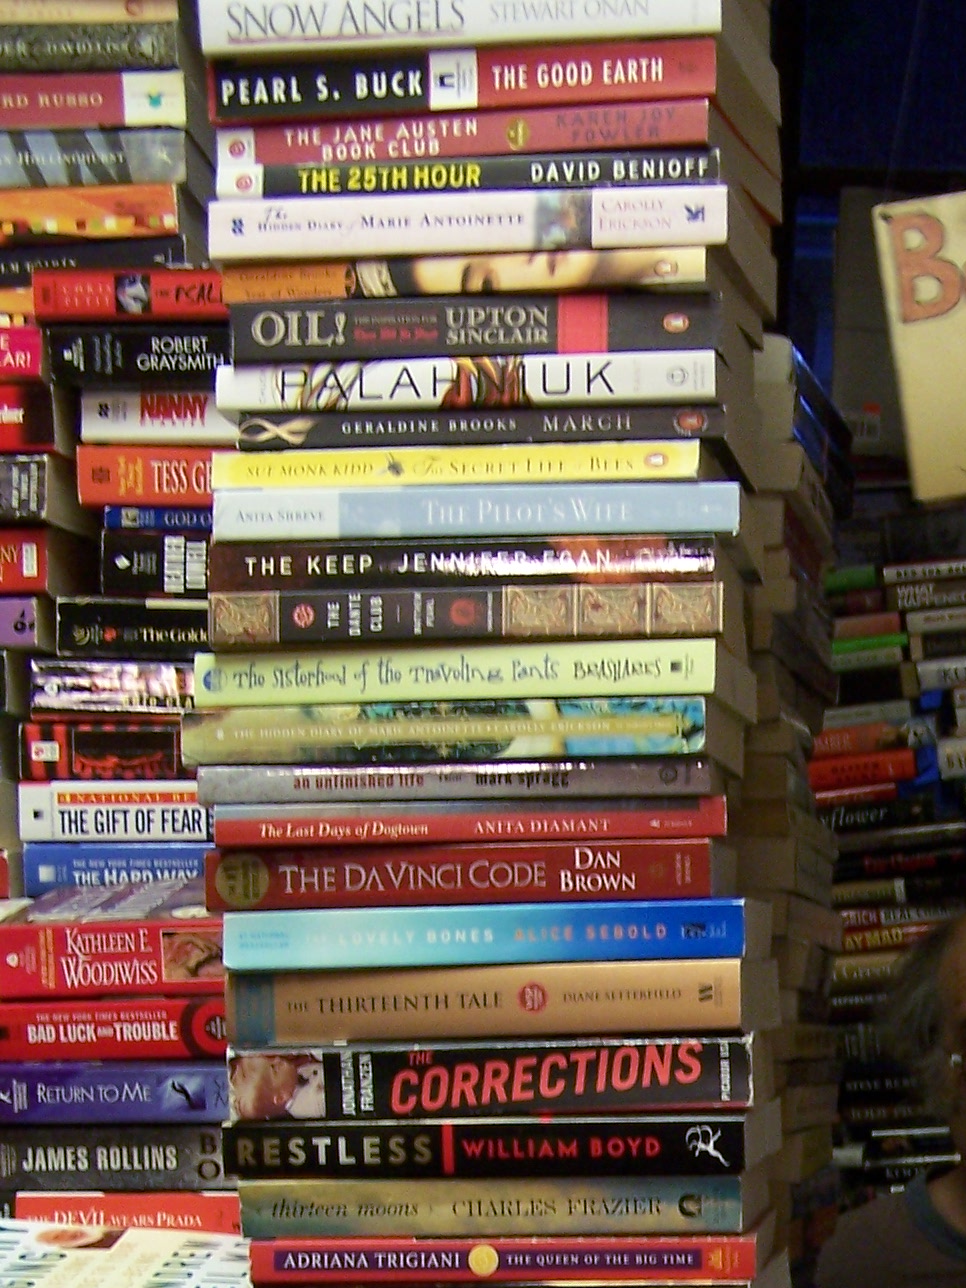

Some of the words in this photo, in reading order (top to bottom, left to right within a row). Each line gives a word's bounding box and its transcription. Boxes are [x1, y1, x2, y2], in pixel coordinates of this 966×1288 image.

[226, 0, 325, 38] SNOW
[334, 0, 464, 36] ANGELS
[491, 63, 528, 91] THE
[536, 60, 593, 89] GOOD
[602, 56, 664, 85] EARTH
[221, 77, 303, 107] PEARL
[315, 74, 341, 103] S.
[354, 69, 423, 99] BUCK
[284, 125, 322, 147] THE
[333, 121, 385, 144] JANE
[395, 117, 479, 142] AUSTEN
[320, 143, 378, 162] BOOK
[386, 139, 441, 157] CLUB
[297, 165, 342, 195] THE
[346, 163, 408, 192] 25TH
[413, 161, 482, 190] HOUR
[530, 159, 601, 185] DAVID
[612, 154, 710, 181] BENIOFF
[250, 308, 348, 347] OIL!
[444, 303, 550, 330] UPTON
[151, 336, 209, 359] ROBERT
[444, 325, 550, 346] SINCLAIR
[341, 417, 440, 438] GERALDINE
[448, 414, 518, 436] BROOKS
[541, 411, 632, 436] MARCH
[151, 460, 190, 494] TESS
[245, 554, 293, 578] THE
[306, 551, 374, 576] KEEP
[59, 808, 89, 836] THE
[94, 808, 130, 837] GIFT
[134, 810, 156, 835] OF
[160, 810, 203, 836] FEAR
[474, 821, 525, 838] ANITA
[574, 847, 621, 870] DAN
[279, 864, 336, 898] THE
[469, 857, 547, 894] CODE
[559, 871, 637, 894] BROWN
[426, 928, 495, 946] BONES
[60, 956, 159, 989] WOODIWISS
[27, 1022, 56, 1044] BAD
[58, 1022, 98, 1044] LUCK
[112, 1022, 179, 1042] TROUBLE
[408, 1051, 433, 1071] THE
[390, 1041, 704, 1116] CORRECTIONS
[36, 1082, 95, 1106] RETURN
[99, 1082, 119, 1102] TO
[120, 1080, 152, 1103] ME
[22, 1144, 89, 1173] JAMES
[96, 1144, 179, 1172] ROLLINS
[236, 1136, 434, 1171] RESTLESS
[461, 1138, 578, 1166] WILLIAM
[590, 1135, 662, 1161] BOYD
[451, 1197, 557, 1219] CHARLES
[567, 1195, 662, 1217] FRAZIER
[283, 1252, 369, 1272] ADRIANA
[373, 1250, 461, 1272] TRIGIANI
[535, 1253, 579, 1268] QUEEN
[634, 1252, 658, 1267] BIG
[662, 1251, 695, 1266] TIME
